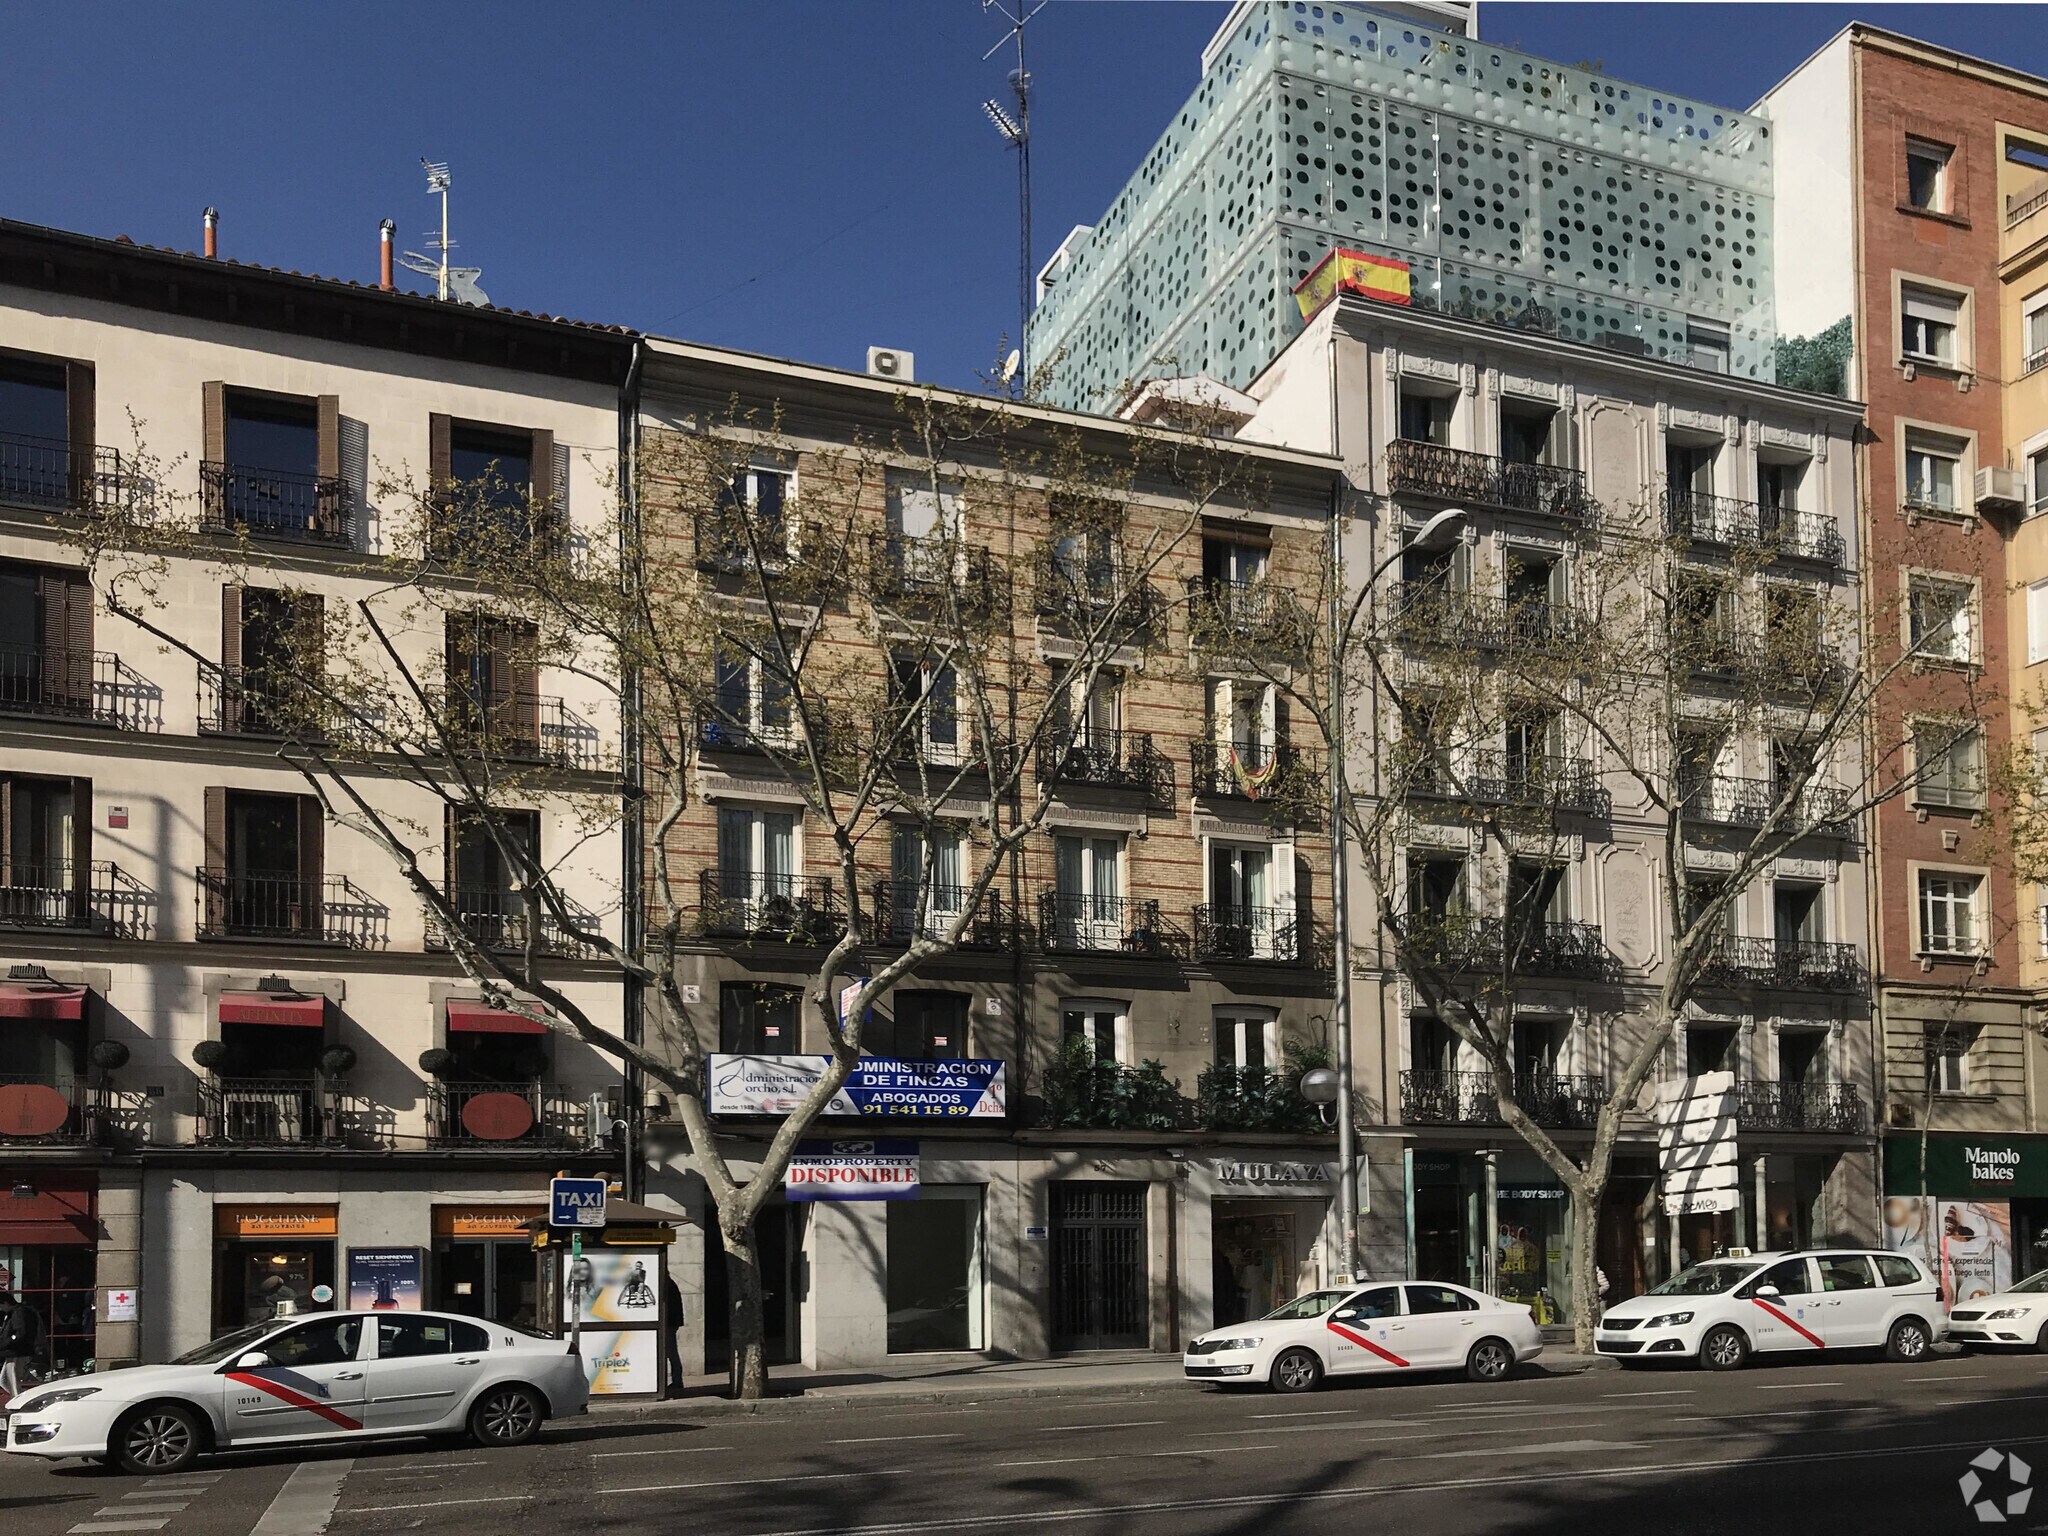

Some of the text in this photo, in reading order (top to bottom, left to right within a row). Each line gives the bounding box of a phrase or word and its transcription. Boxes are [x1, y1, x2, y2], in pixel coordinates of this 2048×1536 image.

[237, 1009, 304, 1023] AFFINITY
[852, 1061, 992, 1075] DMINISTRACIÓN
[863, 1075, 969, 1087] DE FINCAS
[871, 1092, 961, 1104] ABOGADOS
[863, 1104, 969, 1115] 91 541 15 89
[792, 1158, 914, 1166] INMOPROPERTY
[1965, 1147, 2020, 1165] Manolo
[791, 1167, 917, 1183] DISPONIBLE
[1216, 1161, 1330, 1181] MULAYA
[1972, 1163, 2014, 1180] bakes
[556, 1191, 602, 1207] TAXI
[1497, 1190, 1565, 1199] HE BODY SHOP
[504, 1336, 515, 1347] M
[591, 1356, 630, 1369] Triplex
